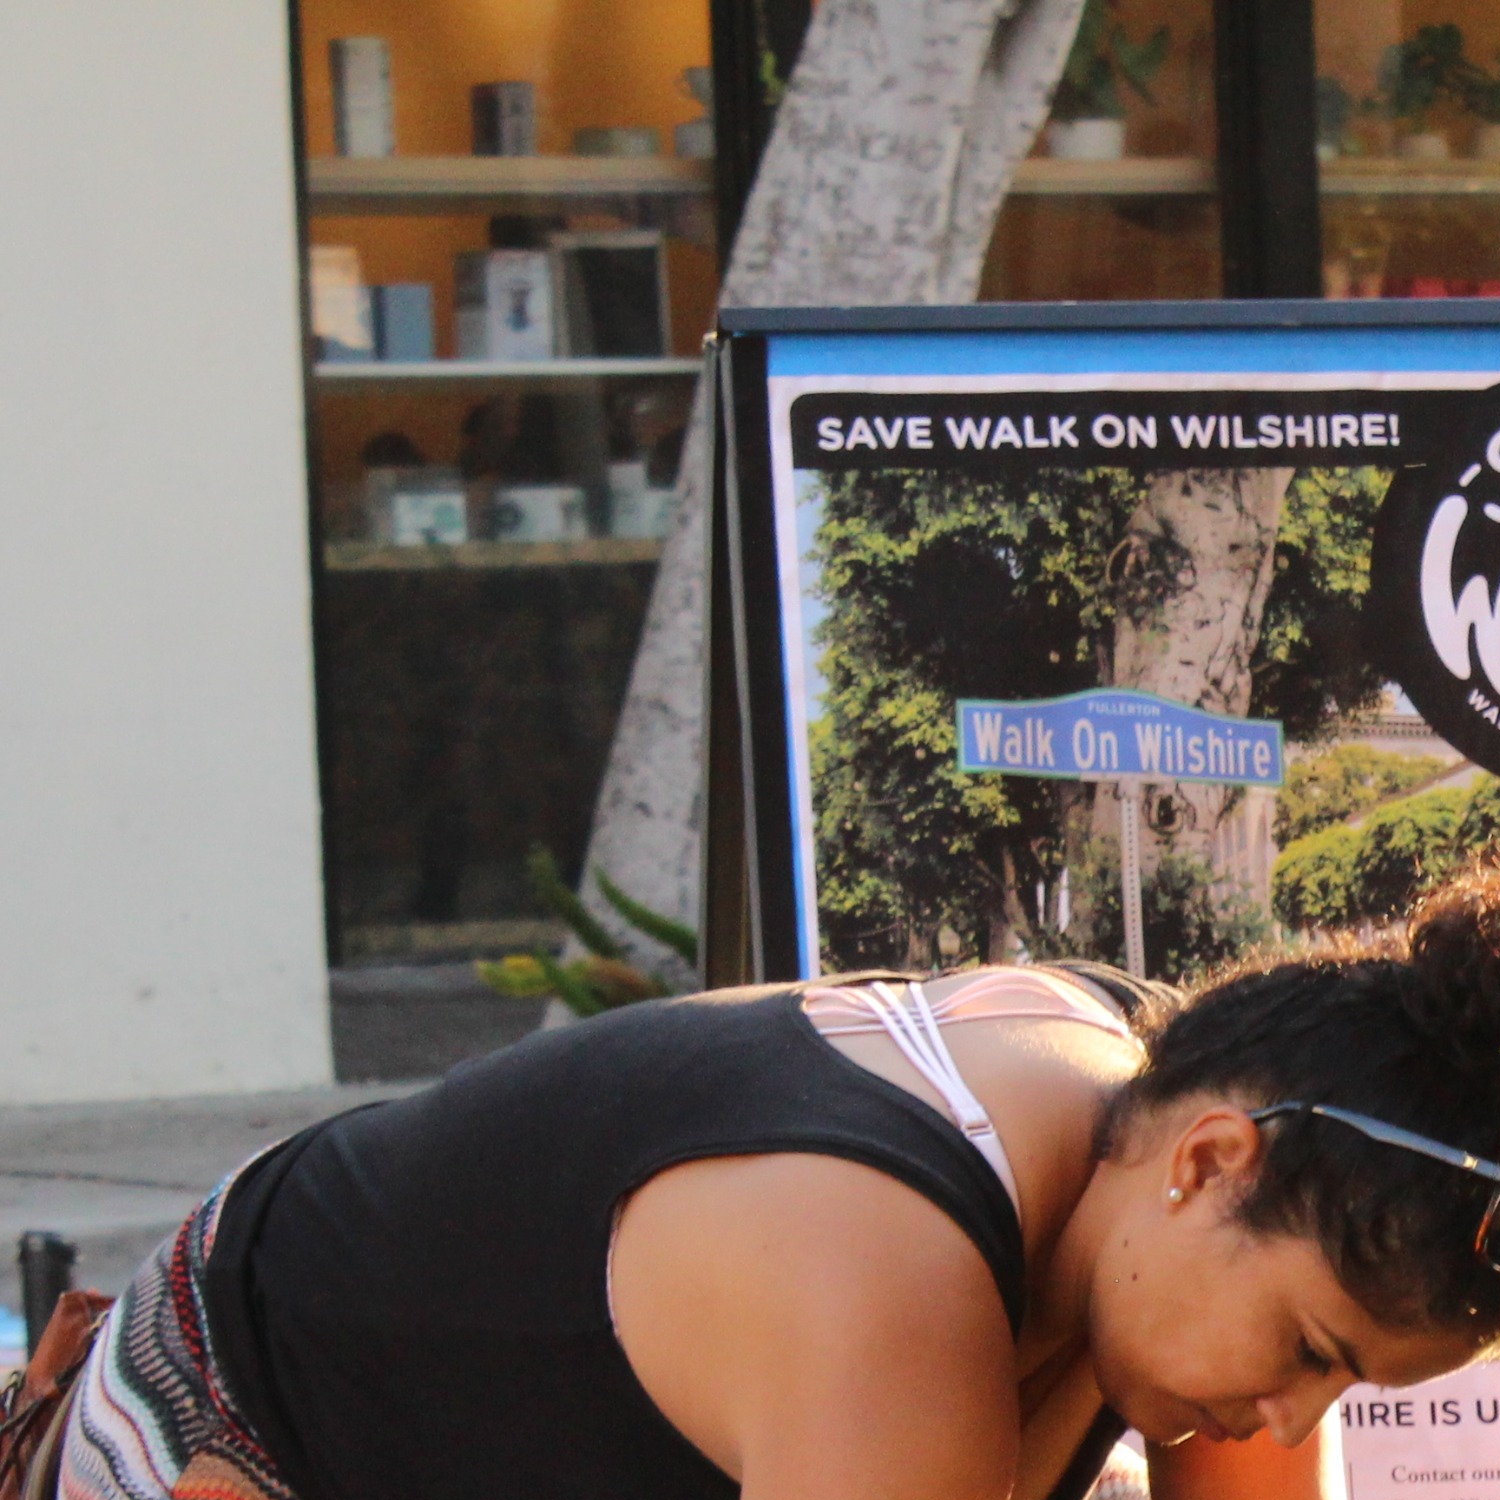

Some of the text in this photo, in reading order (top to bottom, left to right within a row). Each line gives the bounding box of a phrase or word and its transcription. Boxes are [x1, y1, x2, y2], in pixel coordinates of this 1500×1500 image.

[818, 413, 1401, 451] SAVE WALK ON WILSHIRE!
[1087, 702, 1160, 717] FULLERTON
[973, 711, 1272, 777] Walk On Wilshire
[1430, 1399, 1461, 1426] IS
[1391, 1465, 1466, 1484] Contact
